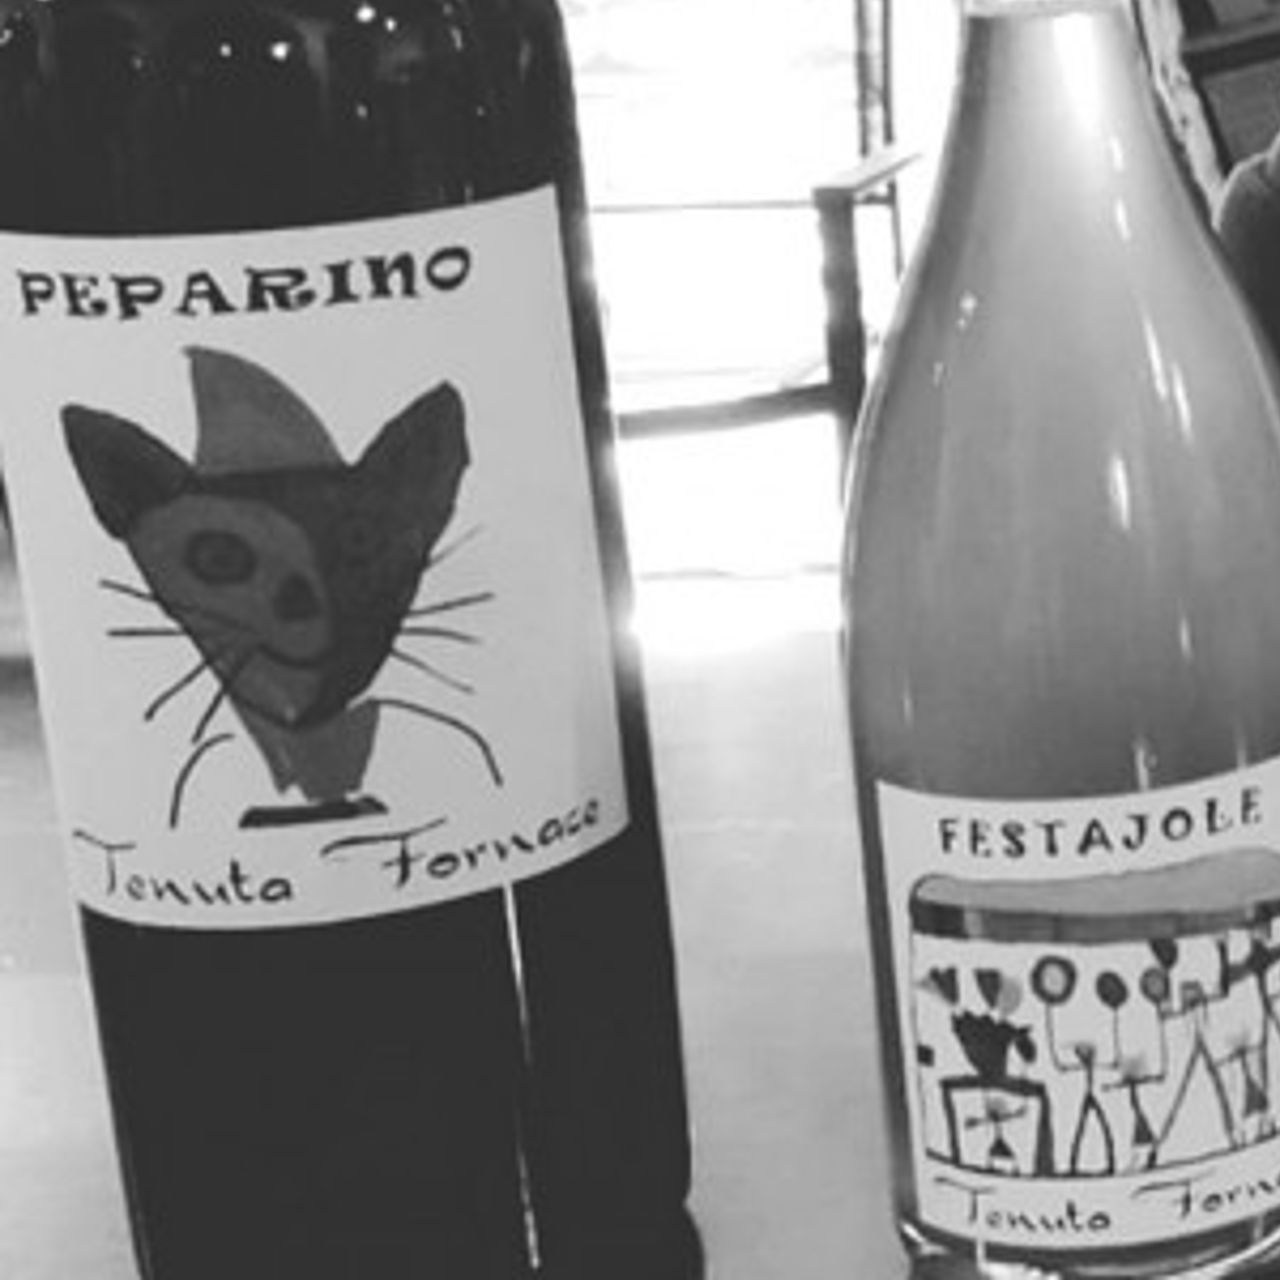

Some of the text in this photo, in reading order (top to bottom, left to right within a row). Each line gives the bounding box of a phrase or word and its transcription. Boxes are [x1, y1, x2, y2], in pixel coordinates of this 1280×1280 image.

[16, 244, 473, 321] PEPARINO
[73, 812, 600, 905] Tenuta Fornace
[938, 786, 1262, 860] FESTAJOLE
[932, 1176, 1112, 1234] Tenuta
